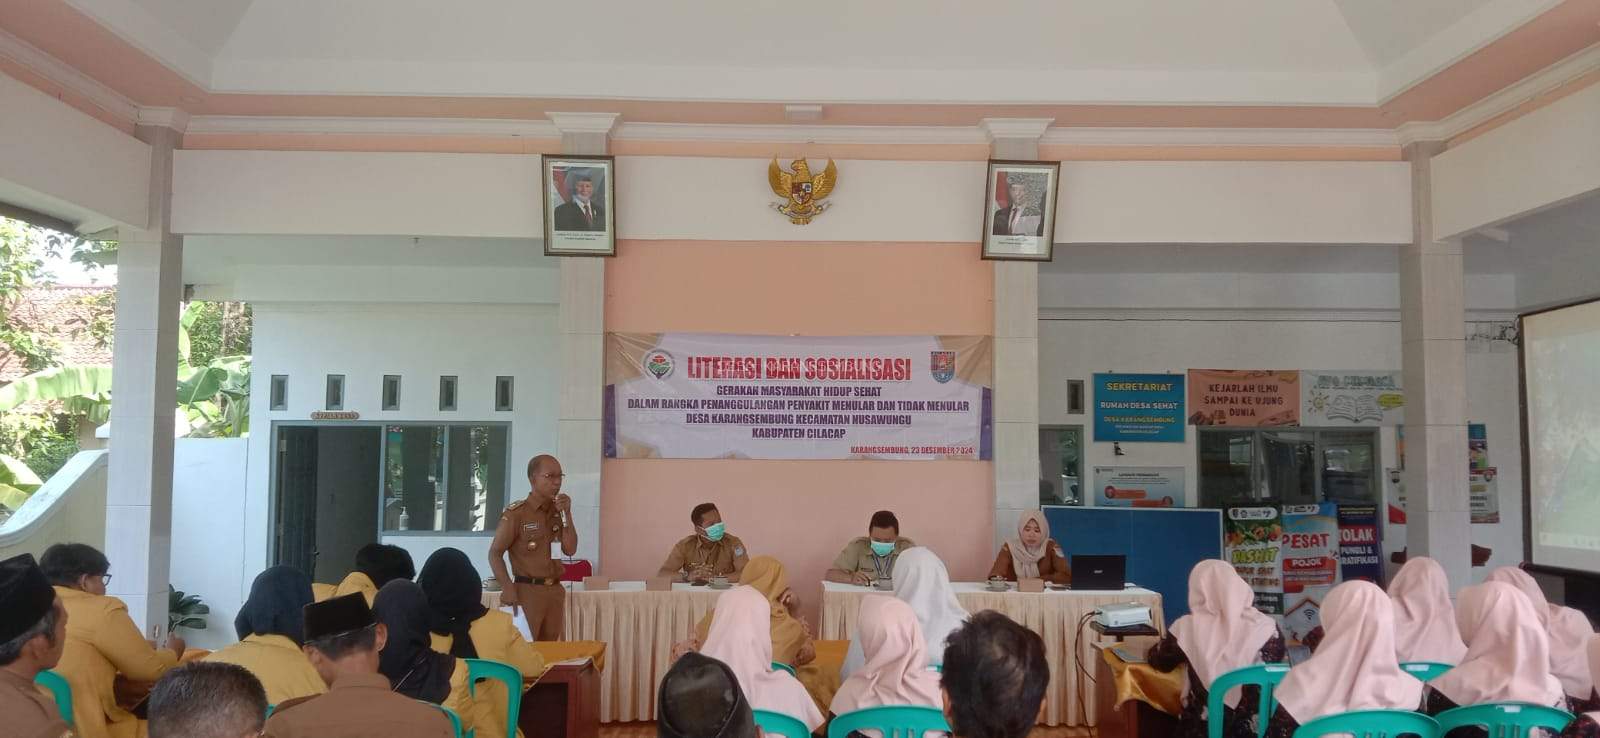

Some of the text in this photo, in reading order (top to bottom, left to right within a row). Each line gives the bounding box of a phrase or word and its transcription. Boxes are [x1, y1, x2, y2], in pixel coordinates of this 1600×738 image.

[687, 356, 911, 381] LITERASI DAN SOSIALISASI
[1106, 382, 1173, 391] SEKRETARIAT
[1209, 384, 1279, 393] KEJARLAH ILMU
[716, 385, 882, 398] GERAKAN MASYARAKAT HIDUP SEHAT
[627, 398, 970, 412] DALAM RANGKA PENANGGULANGAN PENYAKIT MENULAR DAN TIDAK MENULAR
[1204, 396, 1284, 405] SAMPAI KE UJUNG
[1100, 401, 1178, 410] RUMAH DESA SEHAT
[1229, 408, 1256, 417] DUNIA
[686, 413, 912, 426] DESA KARANGSEMBUNG KECAMATAN NUSAWUNGU
[752, 427, 847, 440] KABUPATEN CILACAP
[911, 446, 920, 454] 23
[921, 446, 955, 455] DESEMBER
[955, 446, 974, 455] 2024
[1282, 532, 1330, 549] PESAT
[1292, 558, 1322, 567] POJOK
[1341, 556, 1379, 565] RATIFIKASI
